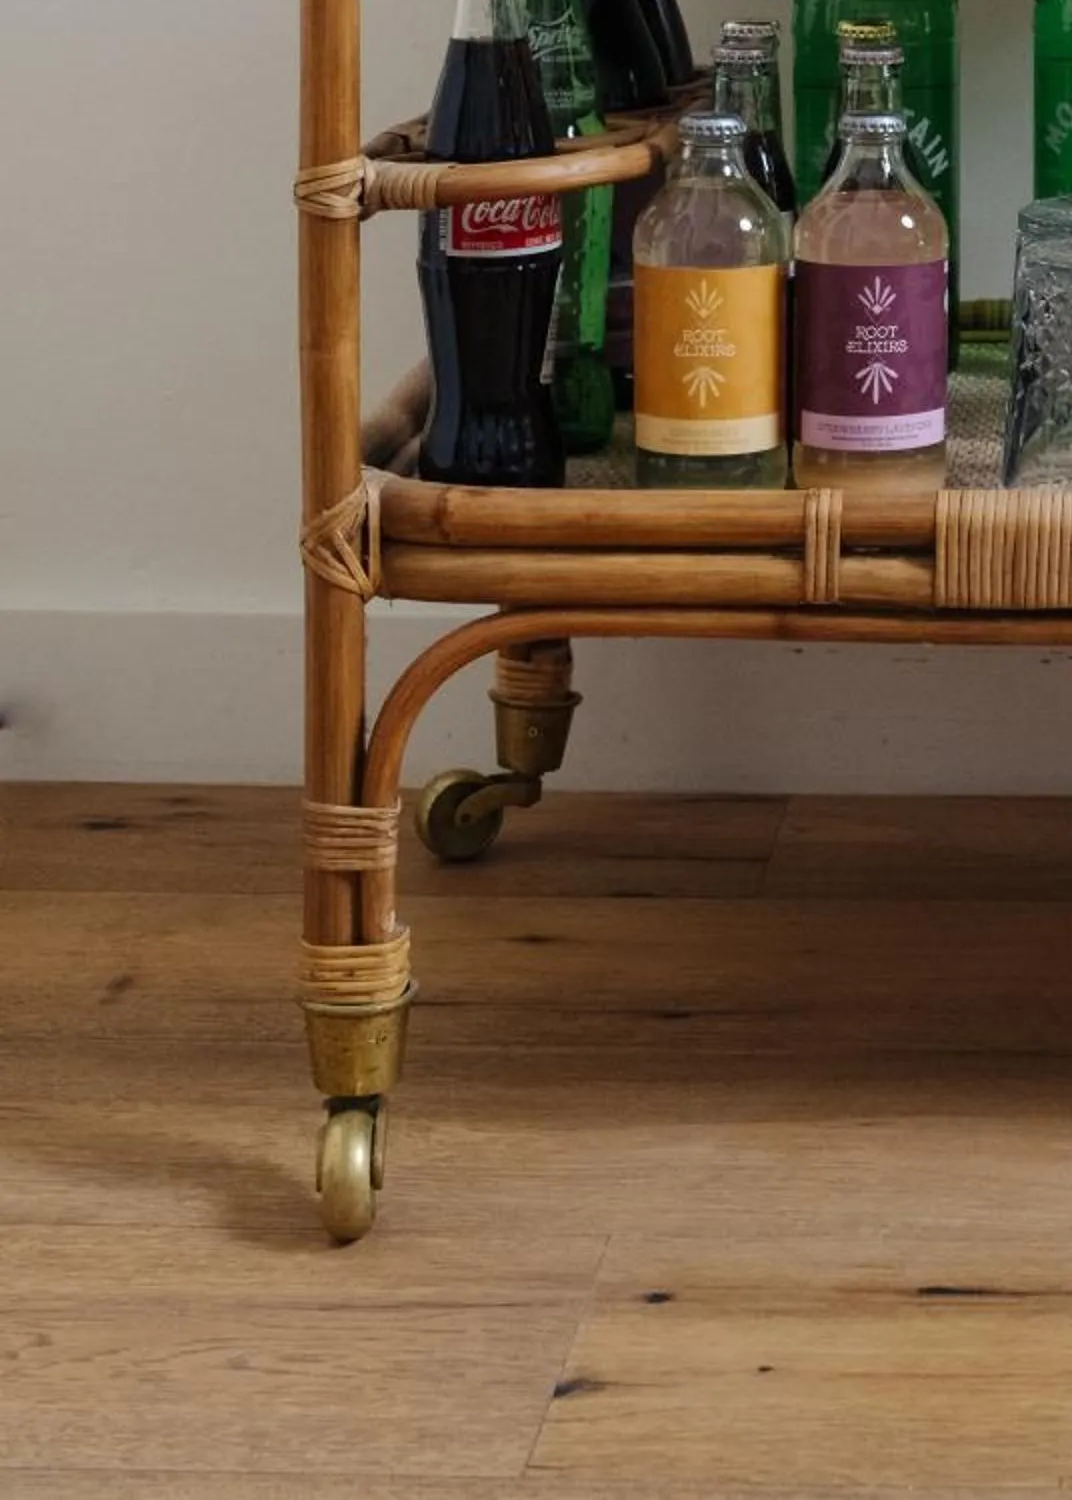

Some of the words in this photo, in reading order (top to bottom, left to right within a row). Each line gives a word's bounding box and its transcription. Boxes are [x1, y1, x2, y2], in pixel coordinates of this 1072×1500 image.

[681, 328, 728, 343] ROOT
[855, 325, 899, 341] ROOT
[673, 342, 737, 357] ELIXIRS
[845, 339, 910, 353] ELIXIRS
